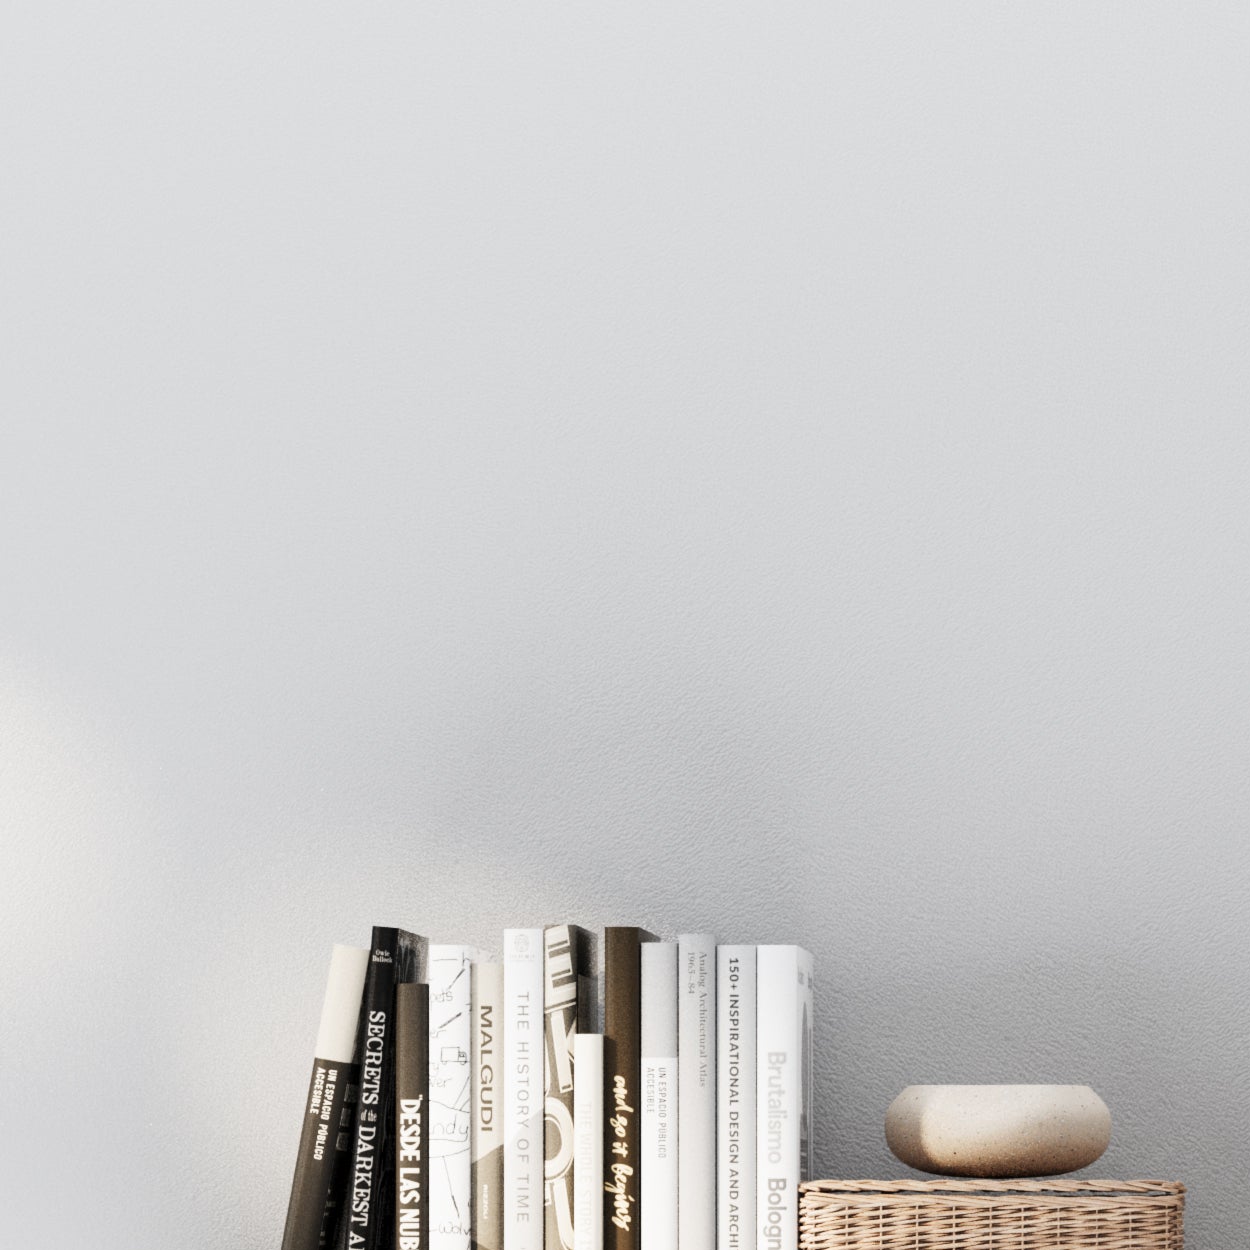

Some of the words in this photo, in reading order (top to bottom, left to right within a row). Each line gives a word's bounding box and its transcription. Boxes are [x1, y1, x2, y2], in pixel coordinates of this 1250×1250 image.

[697, 951, 708, 988] Analog
[729, 957, 740, 988] 150+
[516, 991, 530, 1030] THE
[697, 990, 708, 1059] Architectural
[362, 1011, 386, 1105] SECRETS
[480, 1005, 493, 1132] MALGUDI
[729, 994, 740, 1107] INSPIRATIONAL
[310, 1067, 326, 1114] ACCESIBLE
[327, 1069, 338, 1082] UN
[516, 1040, 530, 1130] HISTORY
[646, 1067, 656, 1113] ACCESIBLE
[657, 1067, 667, 1078] UN
[697, 1061, 708, 1087] Atlas
[320, 1083, 335, 1121] ESPACIO
[578, 1102, 592, 1128] THE
[613, 1075, 634, 1113] and
[657, 1081, 667, 1118] ESPACIO
[767, 1051, 787, 1165] Brutalismo
[516, 1137, 530, 1161] OF
[578, 1132, 592, 1184] WHOLE
[612, 1142, 628, 1158] it
[729, 1111, 740, 1165] DESIGN
[351, 1125, 376, 1226] DARKEST
[400, 1167, 421, 1204] LAS
[516, 1170, 530, 1223] TIME
[729, 1170, 740, 1200] AND
[578, 1189, 592, 1236] STORY
[604, 1163, 635, 1231] begins
